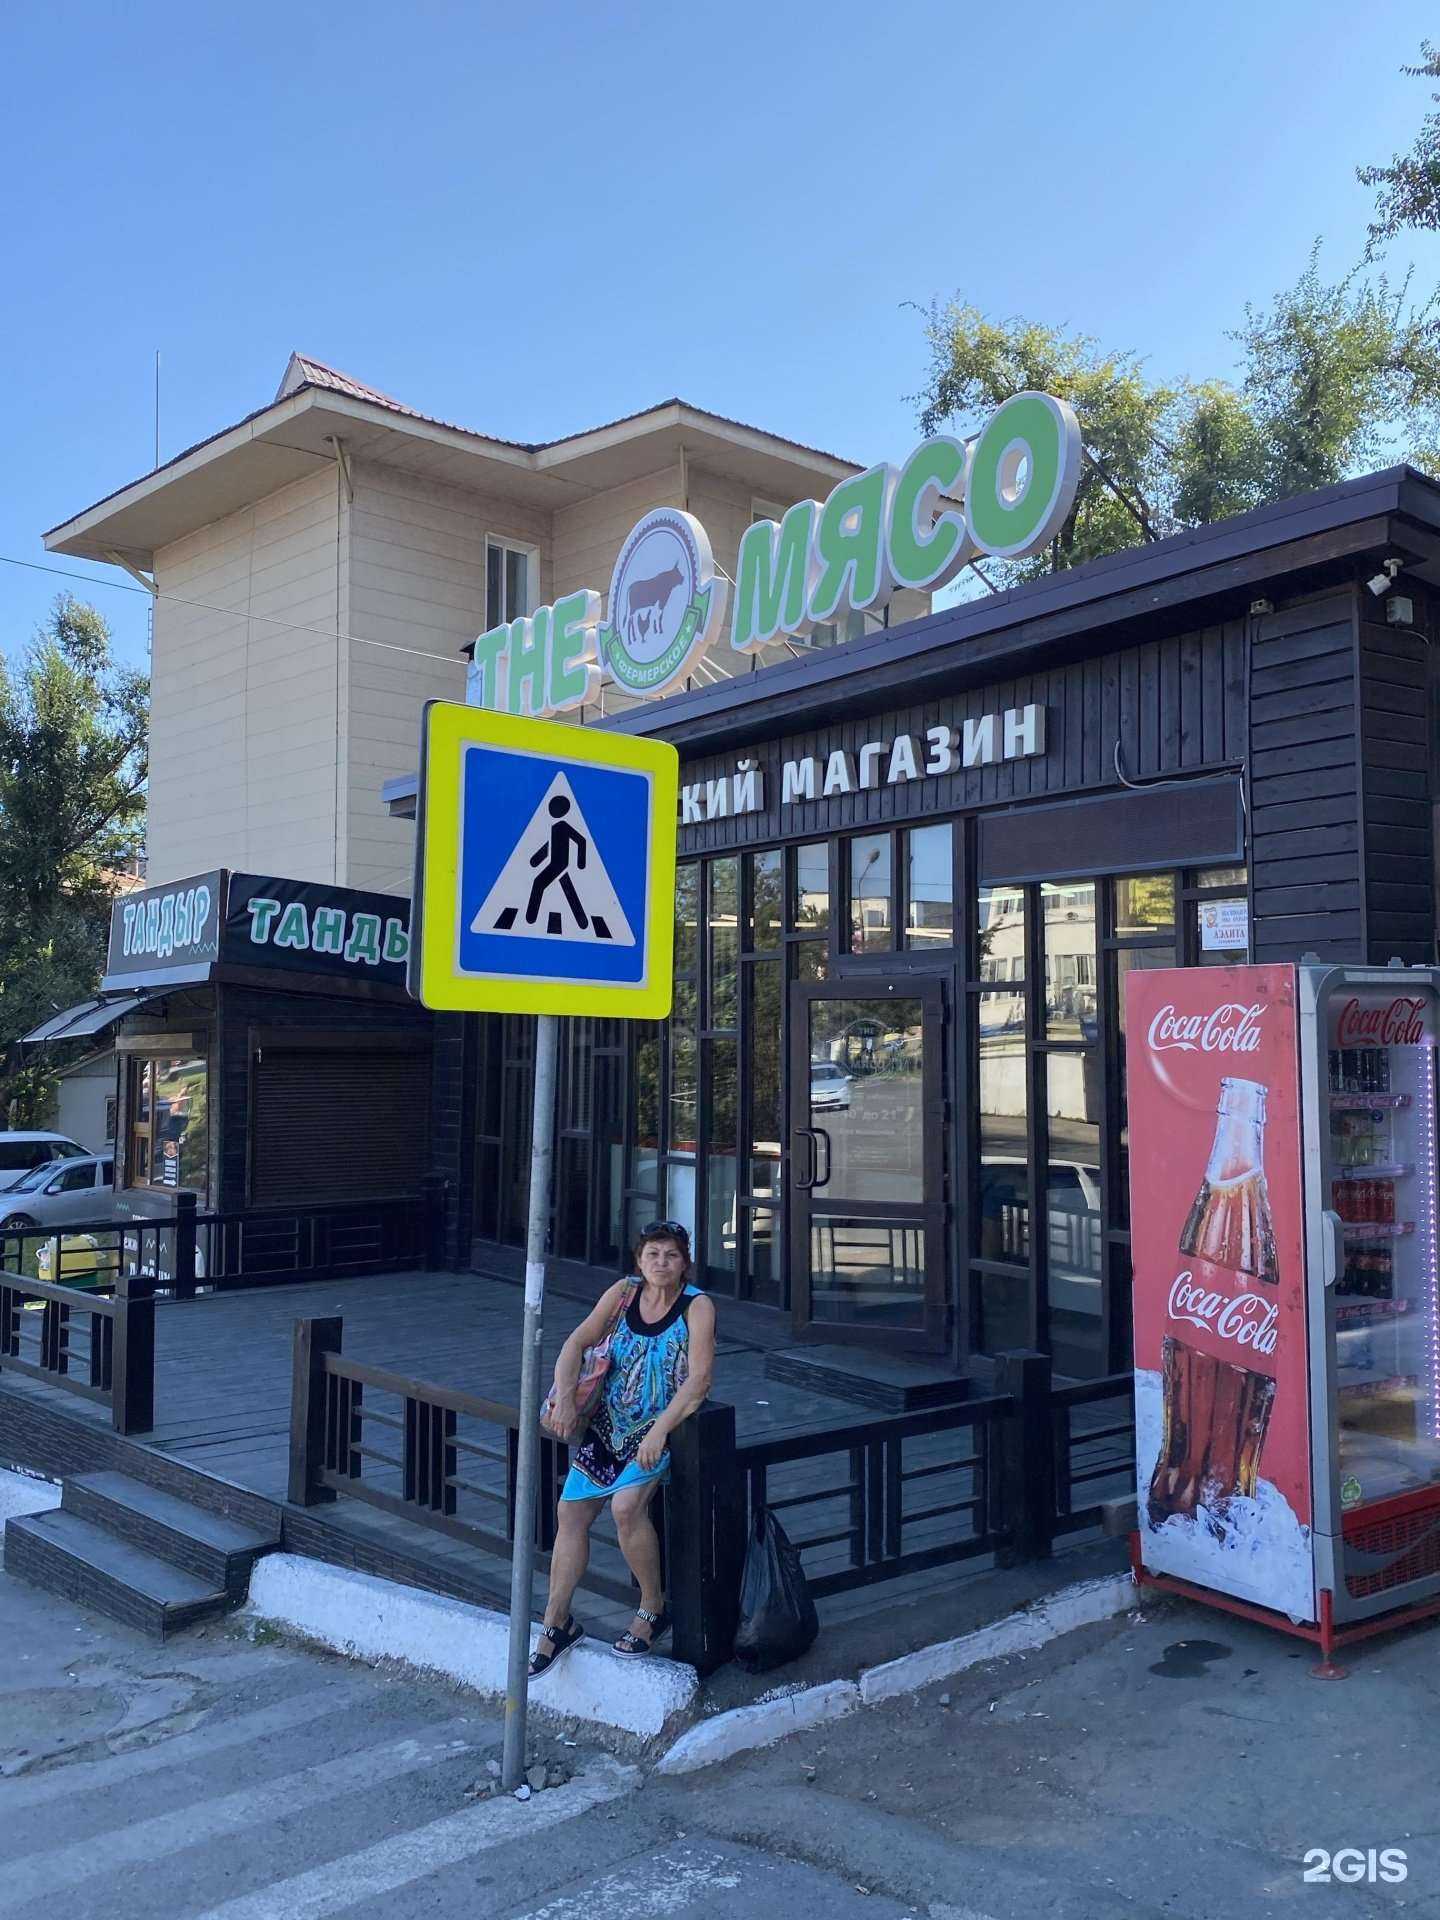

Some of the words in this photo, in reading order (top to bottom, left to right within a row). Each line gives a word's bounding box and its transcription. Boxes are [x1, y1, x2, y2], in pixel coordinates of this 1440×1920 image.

[731, 391, 1080, 653] МЯСО
[618, 636, 687, 682] ФЕРМЕРСКОЕ
[680, 758, 763, 825] КИЙ
[782, 703, 1045, 804] МАГАЗИН
[123, 885, 211, 958] ТАНДЫР
[1148, 1003, 1268, 1052] Coca-Cola
[1338, 997, 1427, 1047] Coca-Cola
[1168, 1270, 1279, 1355] Coca-Cola
